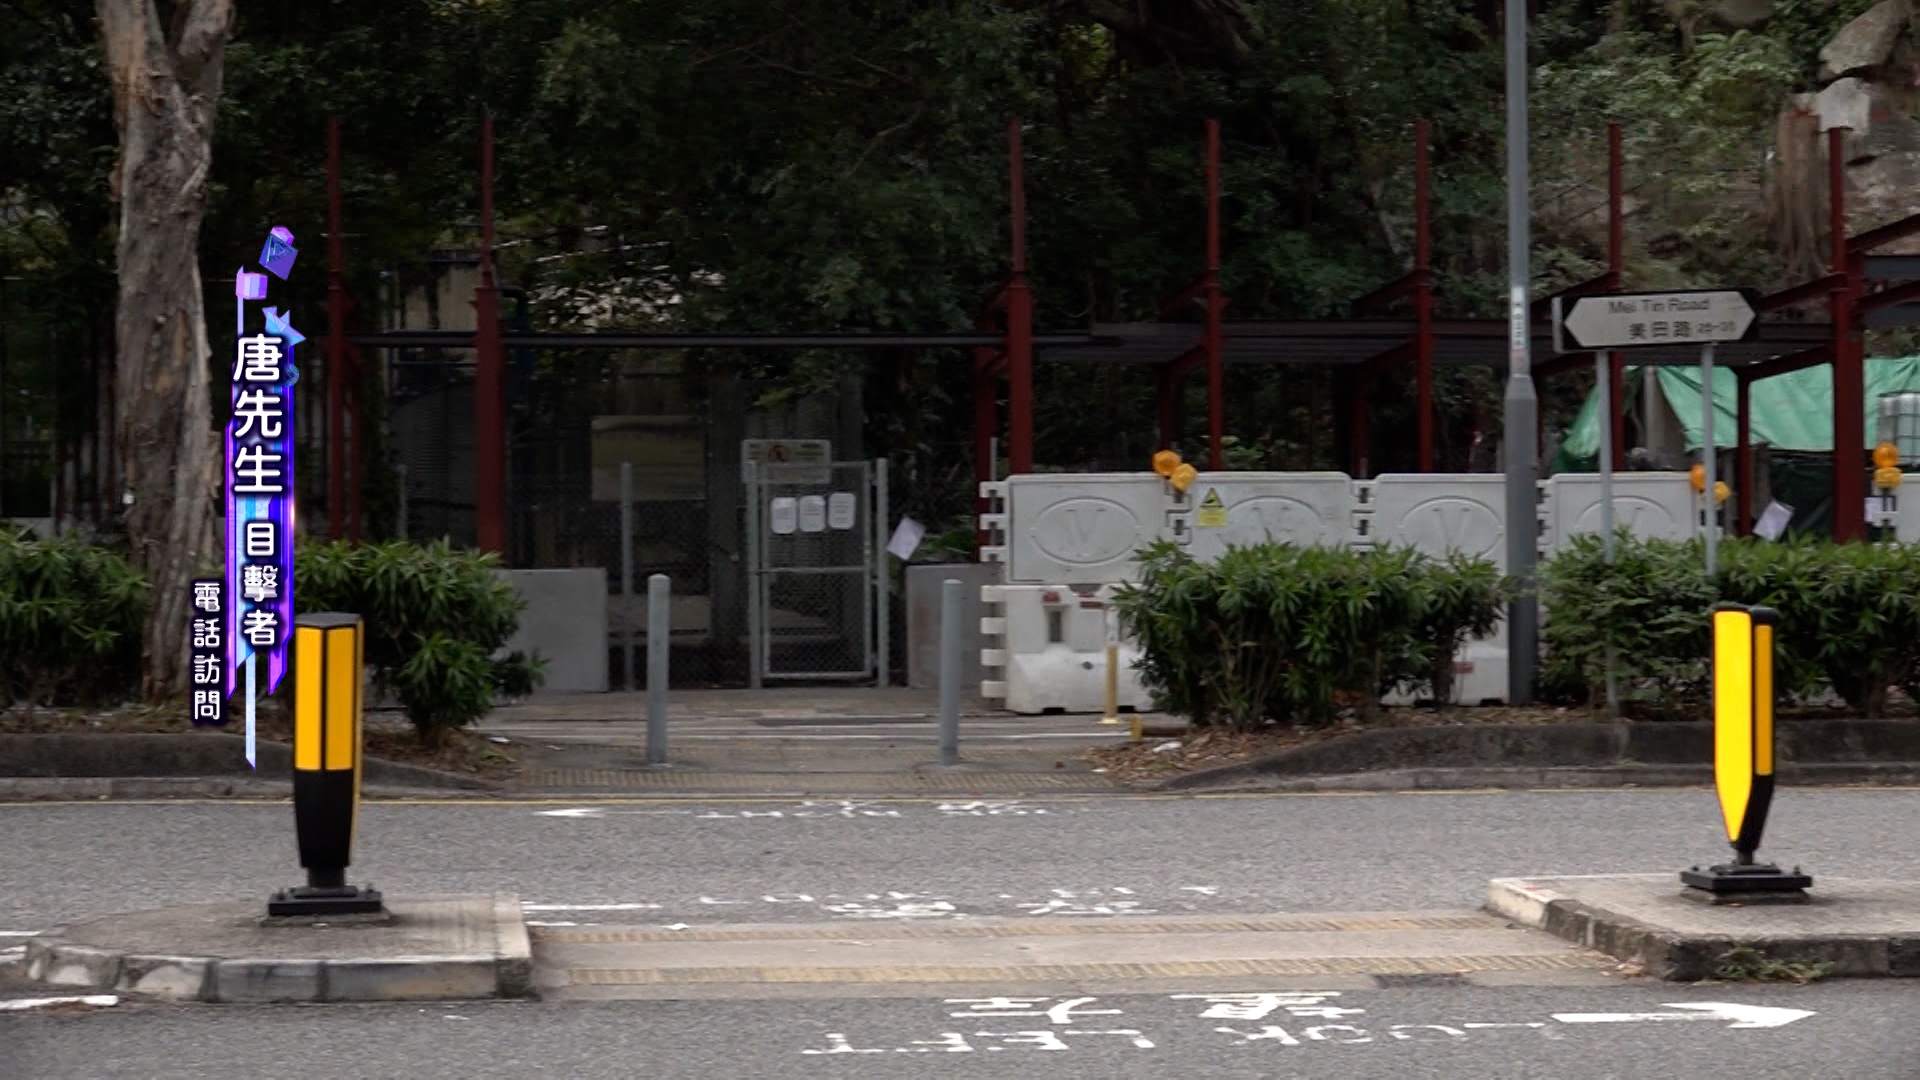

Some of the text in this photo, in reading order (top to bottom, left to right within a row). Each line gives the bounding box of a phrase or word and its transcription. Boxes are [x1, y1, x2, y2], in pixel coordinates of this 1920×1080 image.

[1608, 297, 1710, 313] Mei Tin Road
[1629, 321, 1690, 339] 美田路
[802, 1029, 1155, 1054] LEFT
